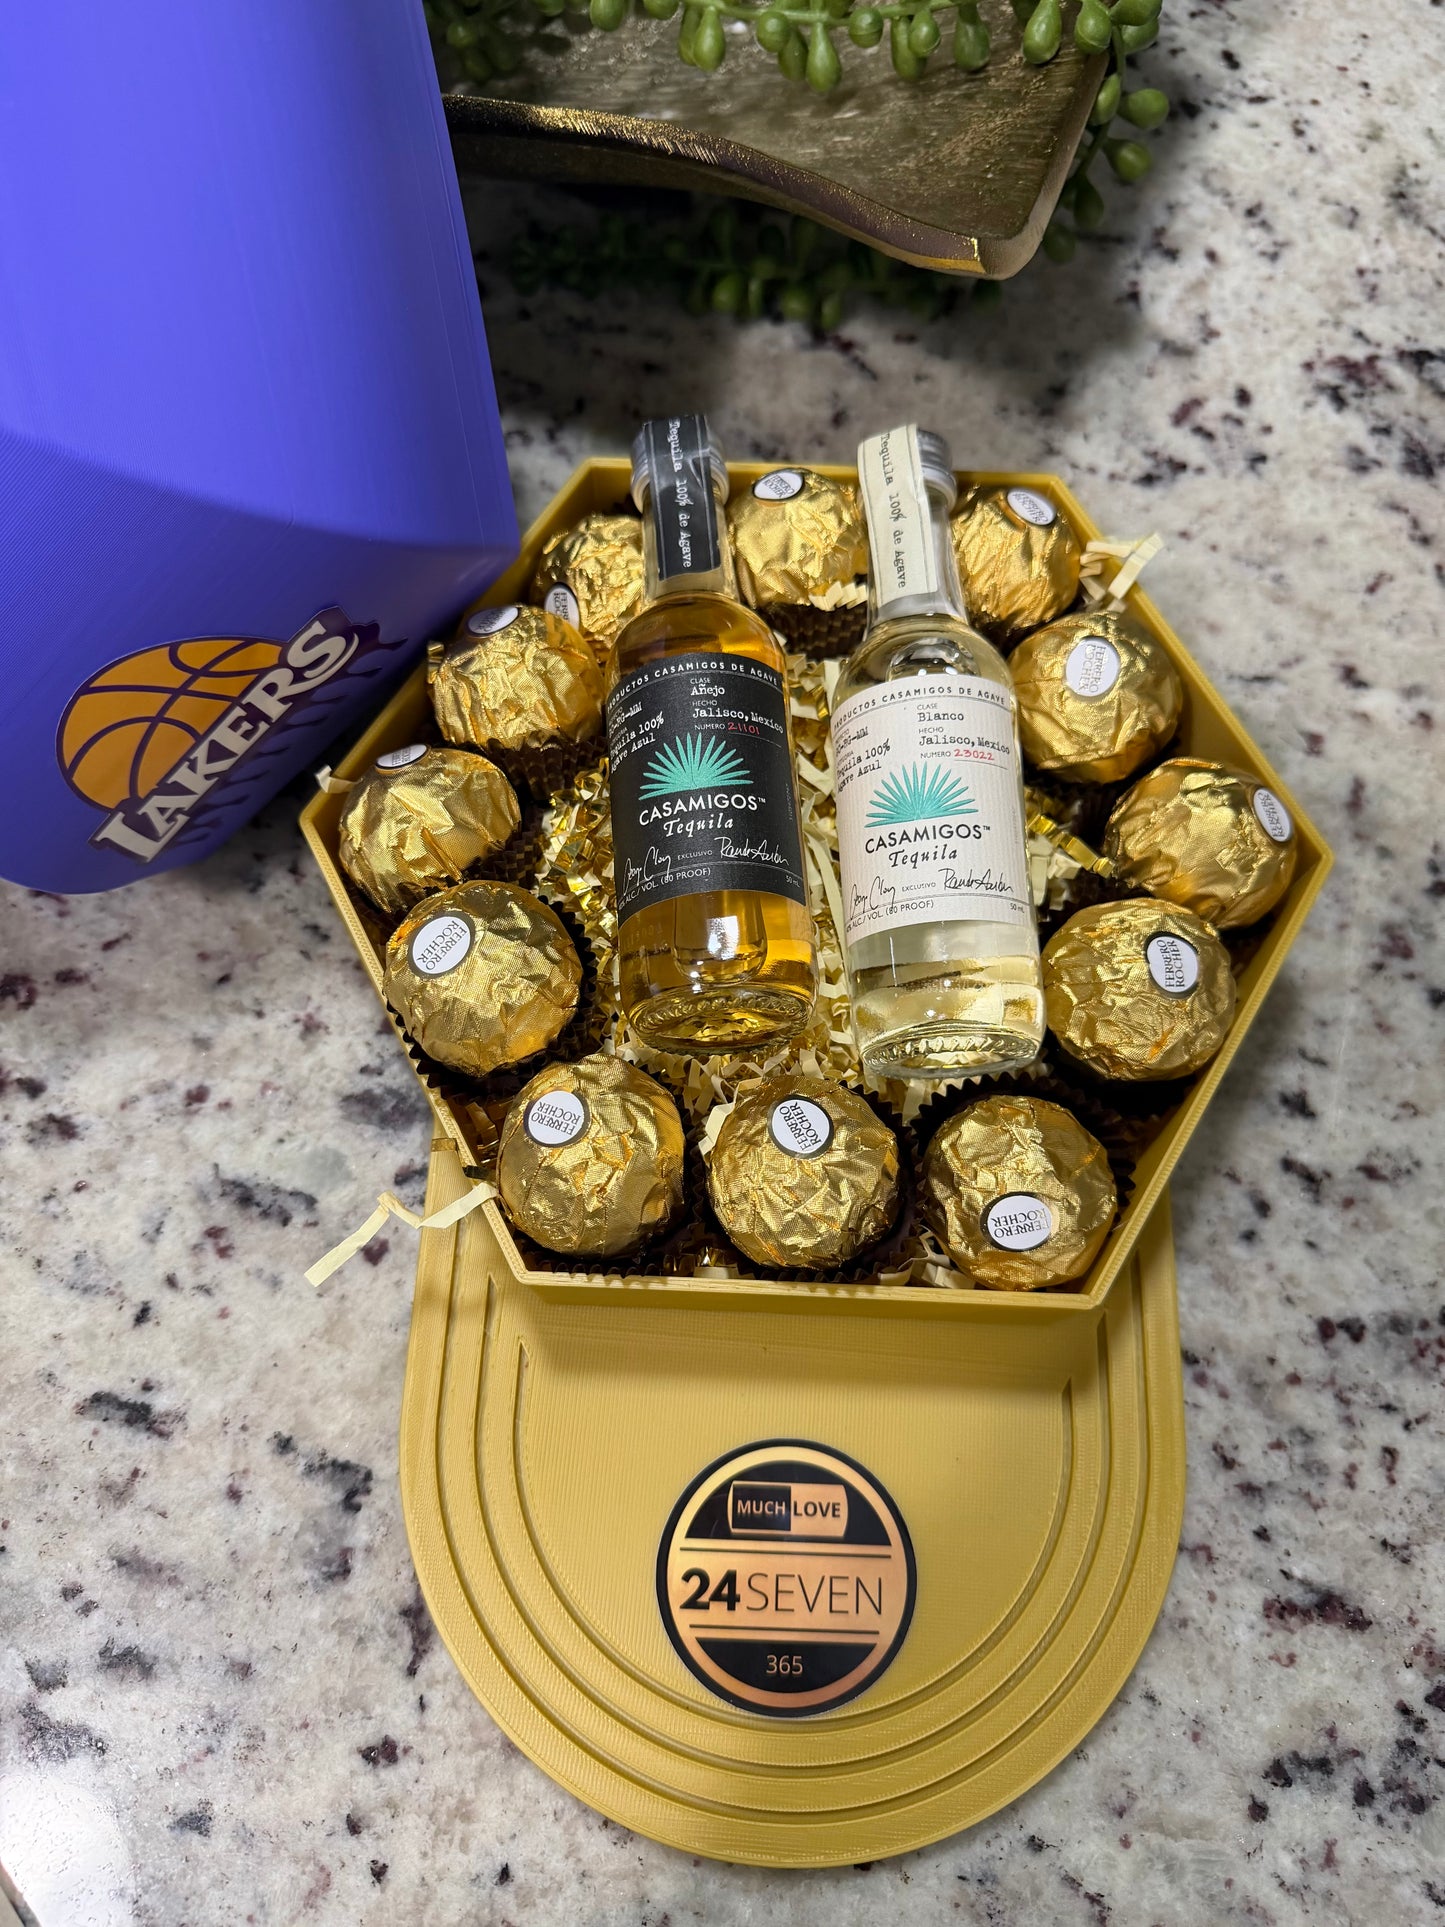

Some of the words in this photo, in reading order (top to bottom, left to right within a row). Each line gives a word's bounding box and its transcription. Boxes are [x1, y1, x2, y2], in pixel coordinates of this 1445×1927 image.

[667, 417, 683, 473] Tequila
[879, 432, 894, 486] Tequila
[676, 478, 694, 506] 100%
[679, 513, 690, 527] de
[889, 494, 907, 522] 100%
[893, 530, 904, 544] de
[679, 532, 692, 568] Agave
[893, 550, 906, 588] Agave
[560, 592, 569, 621] FERR
[654, 662, 725, 678] CASAMIGOS
[731, 663, 745, 673] DE
[750, 667, 778, 686] AGAVE
[690, 677, 711, 685] CLASE
[690, 684, 726, 697] Añejo
[882, 686, 952, 703] CASAMIGOS
[958, 687, 972, 696] DE
[977, 690, 1005, 705] AGAVE
[917, 703, 938, 711] CLASE
[917, 712, 964, 723] Blanco
[638, 711, 665, 735] 100%
[694, 723, 726, 731] NUMERO
[95, 621, 359, 863] LAKERS
[631, 732, 656, 753] Azul
[865, 738, 891, 760] 100%
[920, 751, 952, 759] NUMERO
[954, 749, 995, 761] 23022
[857, 760, 882, 778] Azul
[663, 813, 734, 838] Tequila
[677, 850, 713, 861] EXCLUSIVO
[889, 844, 957, 869] Tequila
[676, 867, 711, 881] PROOF)
[902, 882, 936, 892] EXCLUSIVO
[900, 900, 934, 912] PROOF)
[416, 920, 460, 964] ROCHER
[425, 926, 468, 971] FERRERO
[1156, 939, 1175, 988] FERRERO
[1166, 940, 1186, 988] ROCHER
[531, 1112, 576, 1136] FERRERO
[537, 1101, 582, 1125] ROCHER
[789, 1102, 822, 1146] ROCHER
[779, 1106, 812, 1151] FERRERO
[991, 1208, 1047, 1228] ROCHER
[994, 1219, 1050, 1239] FERRERO
[736, 1500, 786, 1516] MUCH
[792, 1501, 841, 1518] LOVE
[680, 1567, 882, 1615] 24SEVEN
[765, 1654, 804, 1676] 365
